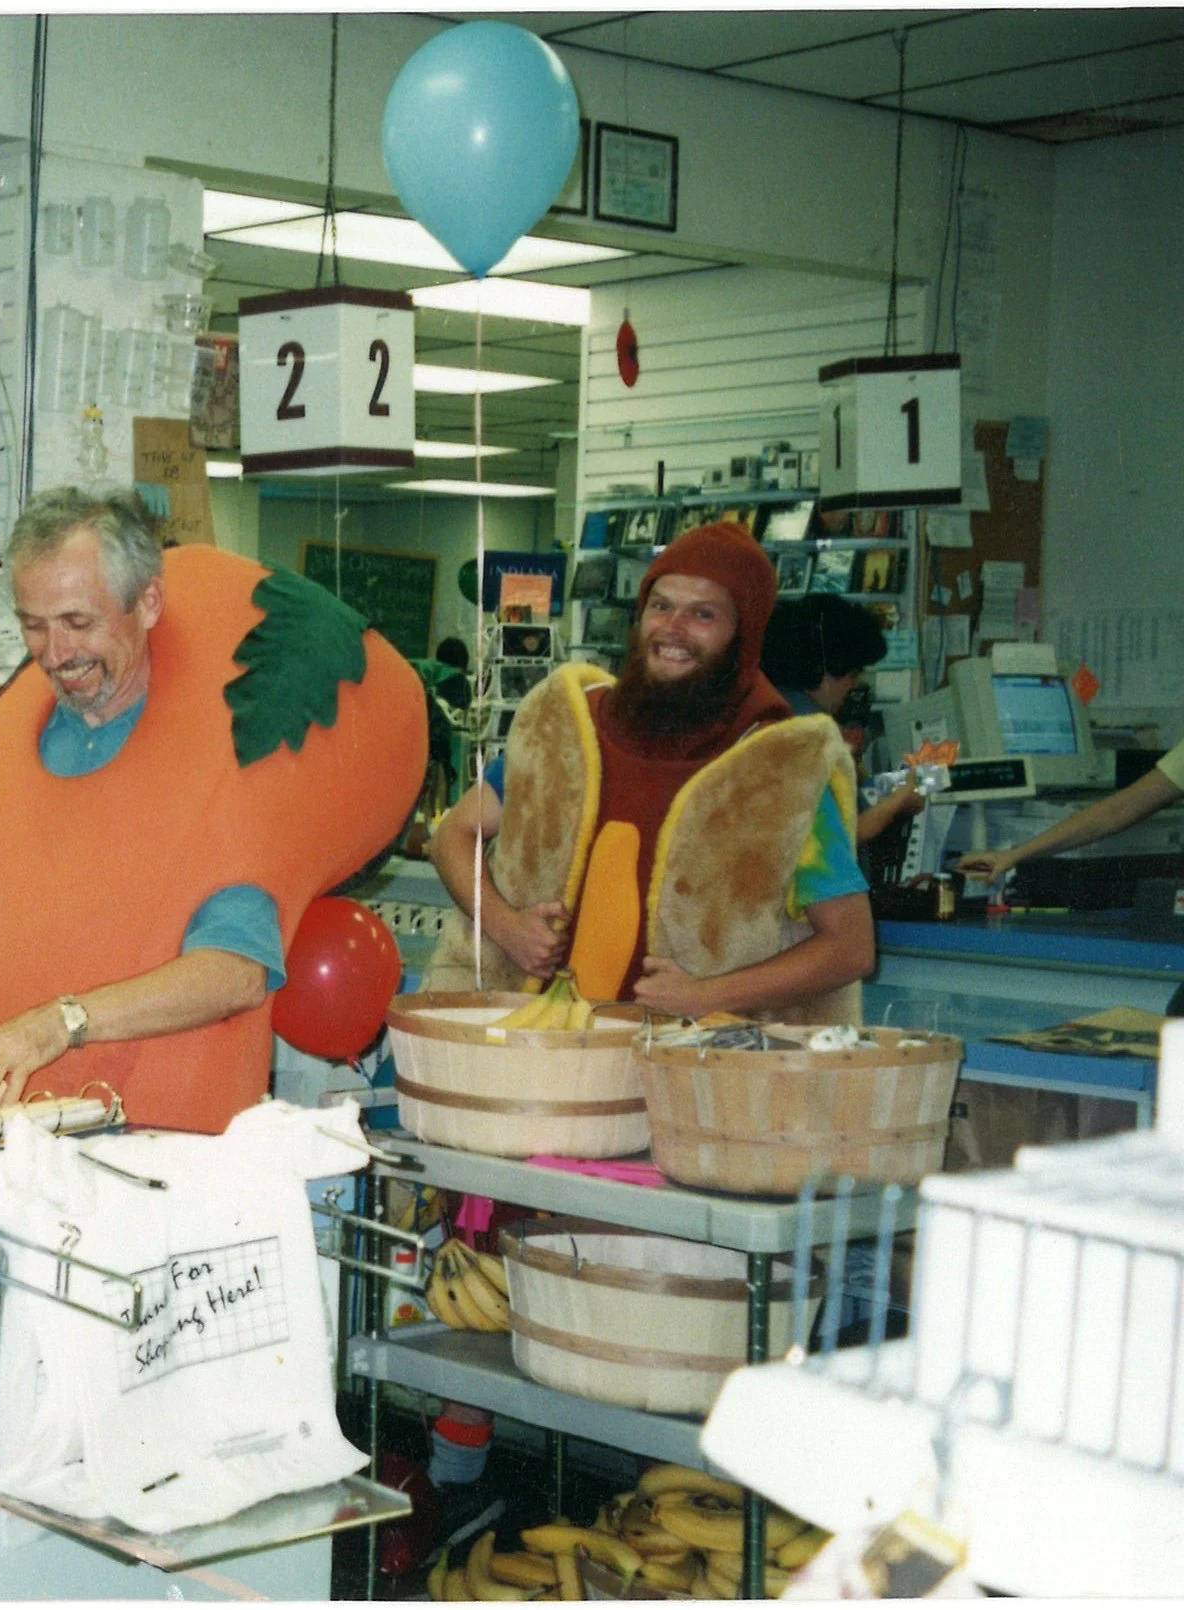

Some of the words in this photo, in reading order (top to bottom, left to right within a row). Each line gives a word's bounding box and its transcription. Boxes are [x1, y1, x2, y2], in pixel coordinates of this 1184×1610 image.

[276, 340, 306, 421] 2
[368, 338, 390, 417] 2
[832, 403, 841, 470] 1
[900, 396, 920, 465] 1
[171, 1261, 214, 1290] For
[206, 1265, 264, 1314] Here!
